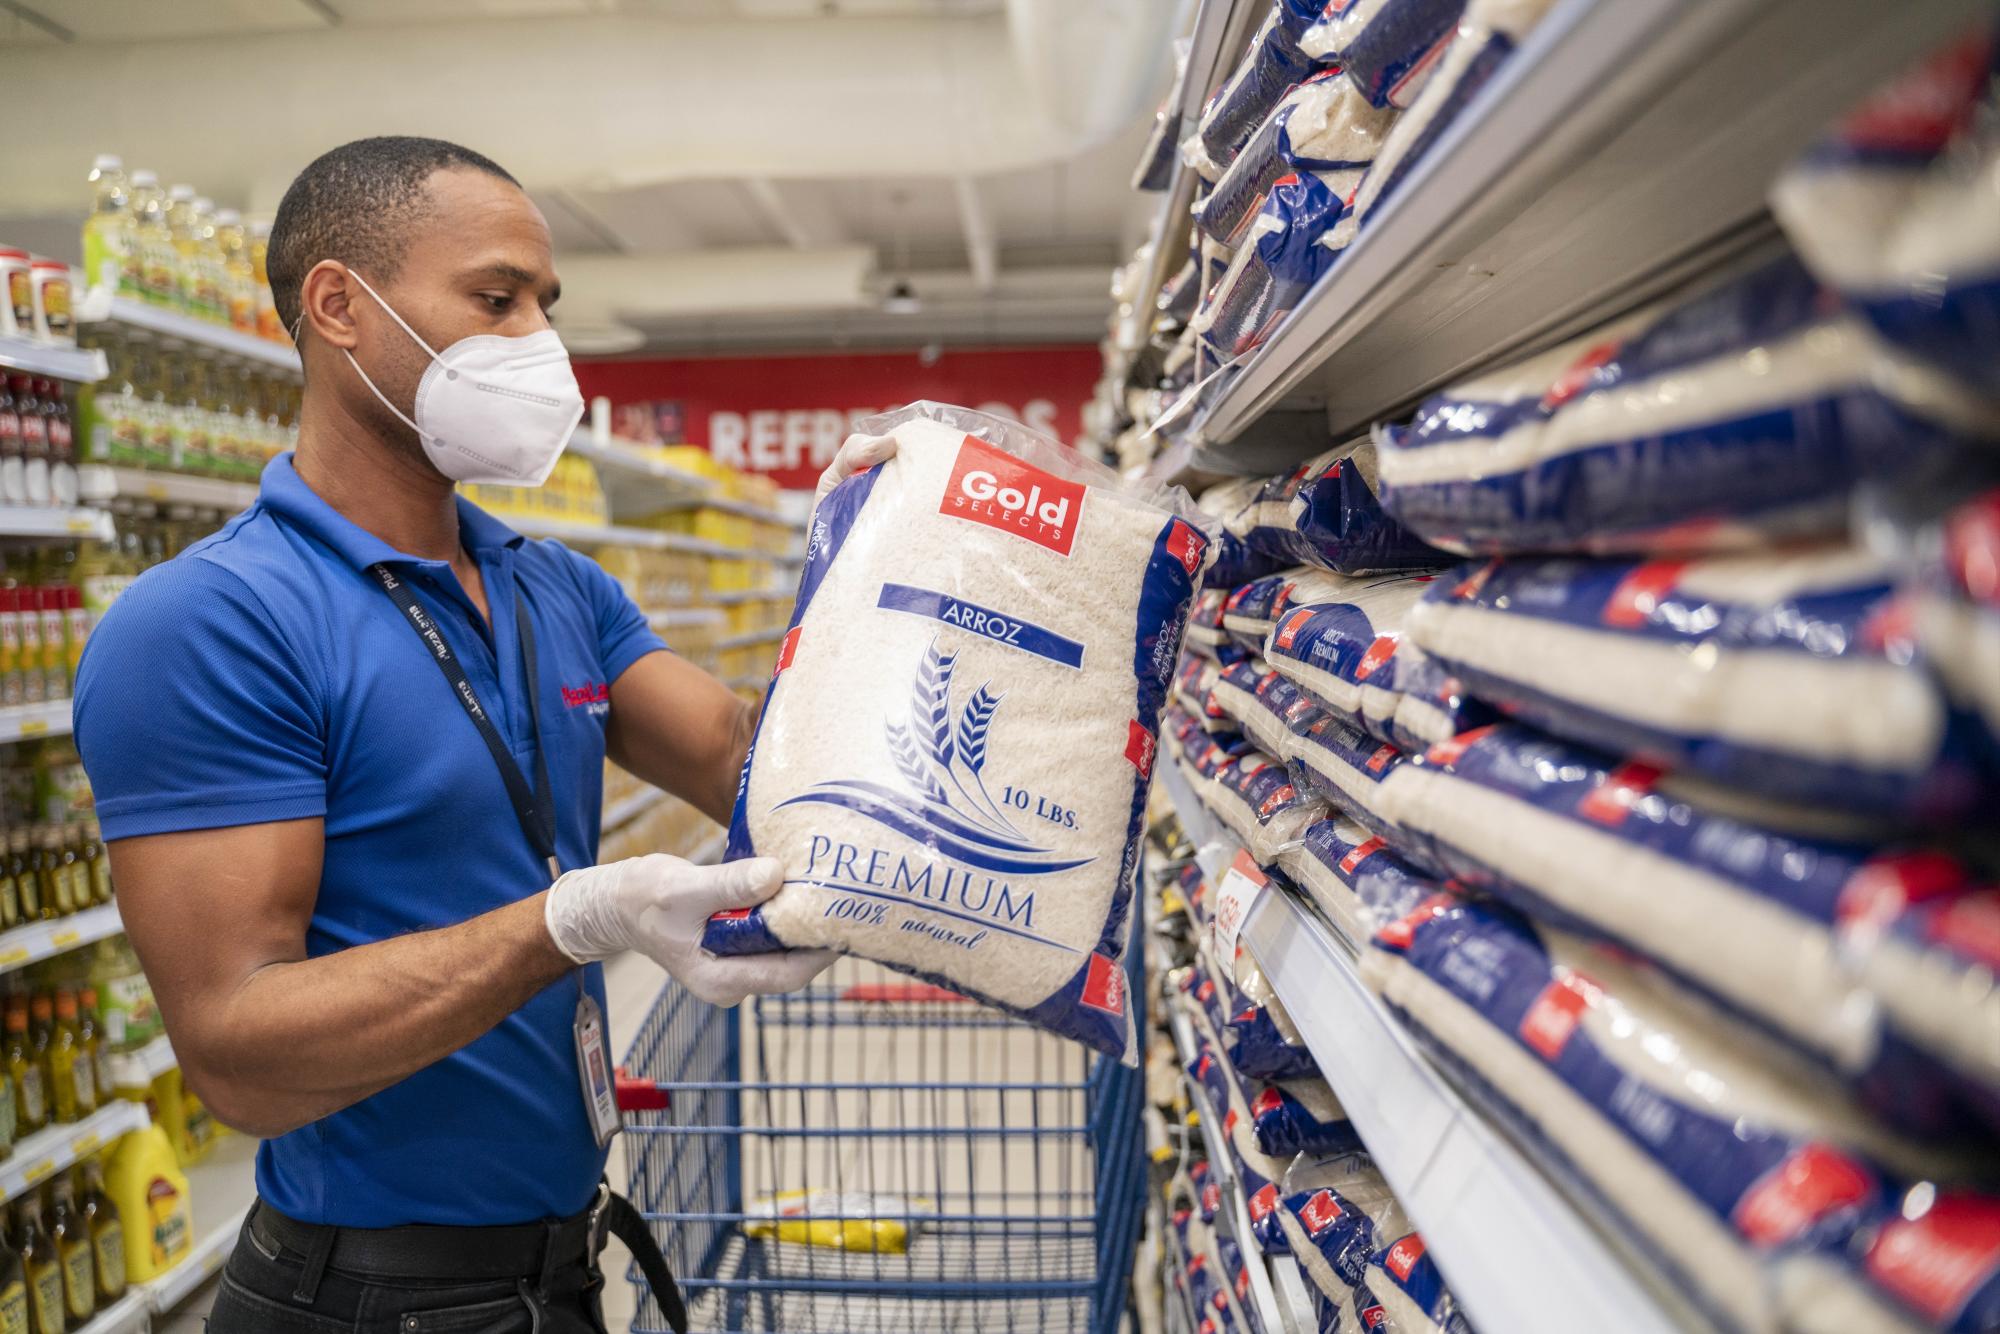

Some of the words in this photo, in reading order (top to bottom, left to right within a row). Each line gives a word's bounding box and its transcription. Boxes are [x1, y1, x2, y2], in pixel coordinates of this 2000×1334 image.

[954, 496, 1062, 540] SELECTS
[961, 470, 1069, 528] Gold
[807, 519, 828, 562] ARROZ
[942, 602, 1024, 645] ARROZ
[1152, 619, 1172, 669] ARROZ
[1311, 639, 1340, 663] PREMIUM
[1139, 734, 1151, 769] Gold
[1002, 785, 1030, 810] 10
[1035, 795, 1079, 830] LBS.
[805, 834, 1036, 928] PREMIUM
[824, 897, 890, 925] 100%
[900, 916, 988, 949] natural
[1106, 964, 1120, 1008] Gold
[1336, 1253, 1365, 1281] PREMI
[1351, 1252, 1368, 1273] ARRO
[1392, 1245, 1416, 1269] Gold
